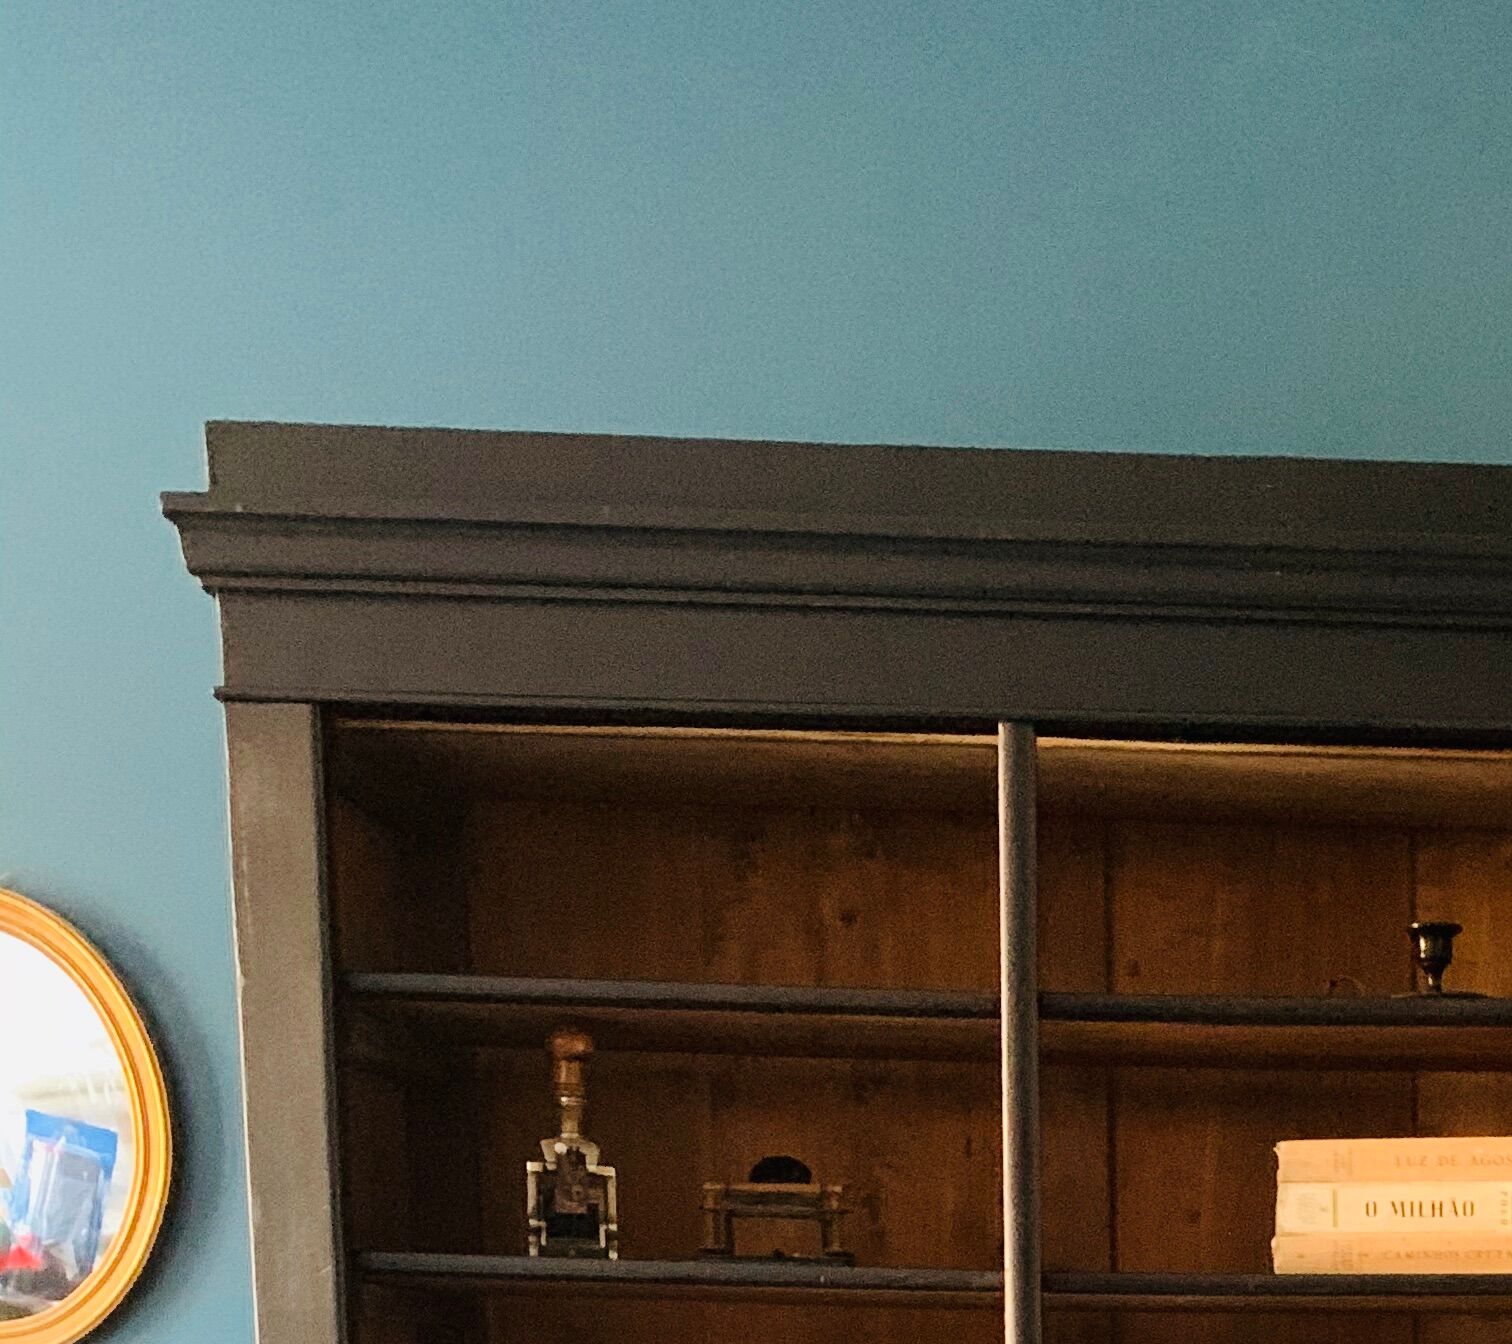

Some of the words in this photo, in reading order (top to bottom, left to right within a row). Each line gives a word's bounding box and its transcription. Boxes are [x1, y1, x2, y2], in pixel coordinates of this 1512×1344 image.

[1393, 1153, 1428, 1168] LUZ
[1437, 1153, 1457, 1167] DE
[1364, 1199, 1378, 1218] O
[1390, 1196, 1475, 1218] MILHÃO
